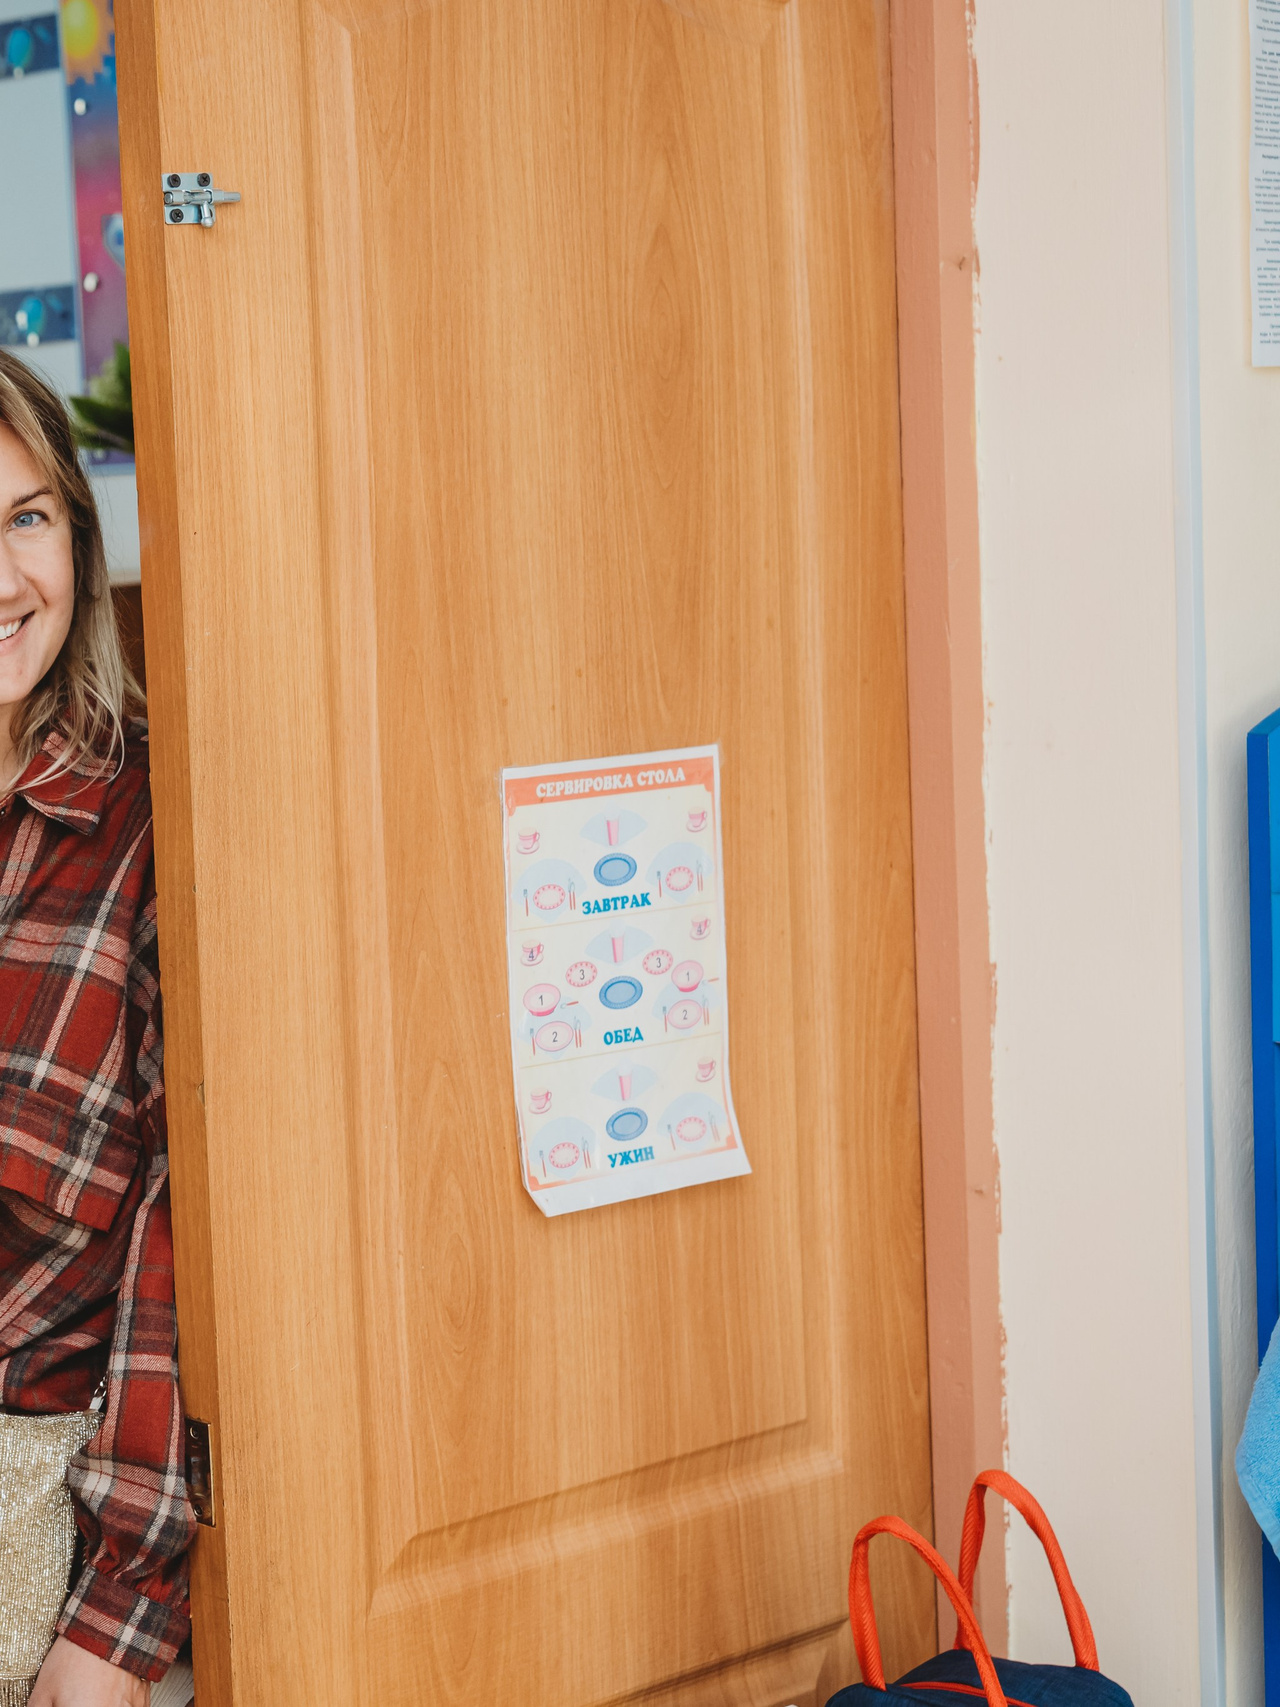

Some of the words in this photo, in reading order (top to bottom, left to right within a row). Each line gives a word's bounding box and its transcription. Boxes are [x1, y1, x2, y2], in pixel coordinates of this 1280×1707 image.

[536, 773, 633, 798] СЕРВИРОВКА
[637, 767, 686, 786] СТОЛА
[582, 892, 651, 915] ЗАВТРАК
[528, 948, 535, 961] 4
[656, 957, 662, 969] 3
[579, 969, 585, 981] 3
[538, 995, 544, 1006] 1
[682, 1010, 688, 1020] 2
[552, 1031, 558, 1043] 2
[603, 1026, 644, 1046] ОБЕД
[607, 1146, 655, 1168] УЖИН
